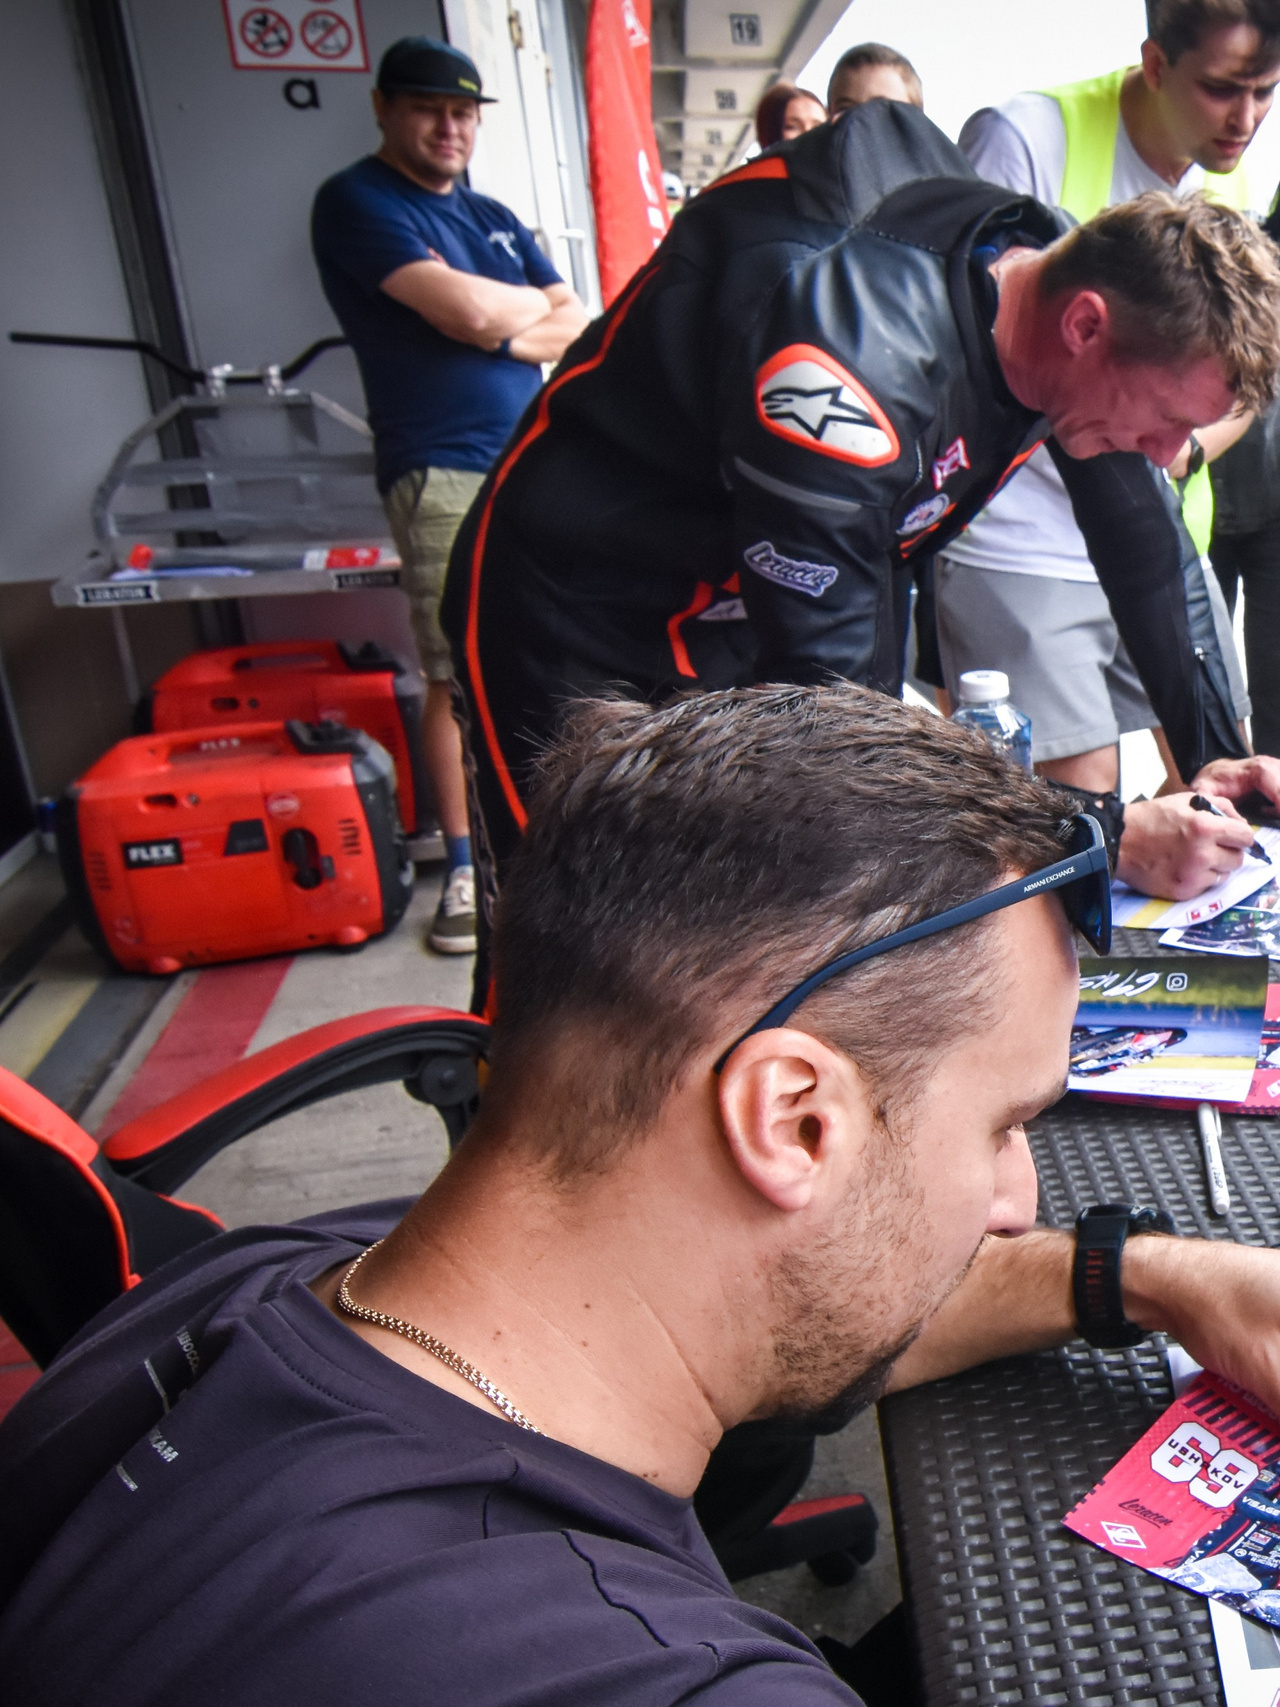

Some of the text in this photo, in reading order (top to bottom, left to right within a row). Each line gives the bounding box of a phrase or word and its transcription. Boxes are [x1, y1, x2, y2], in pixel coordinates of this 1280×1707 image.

[734, 21, 758, 41] 19
[128, 843, 176, 863] FLEX
[1023, 866, 1075, 893] ARMANI EXCHANGE
[1150, 1421, 1260, 1509] 69
[1168, 1438, 1244, 1489] USHAKOV
